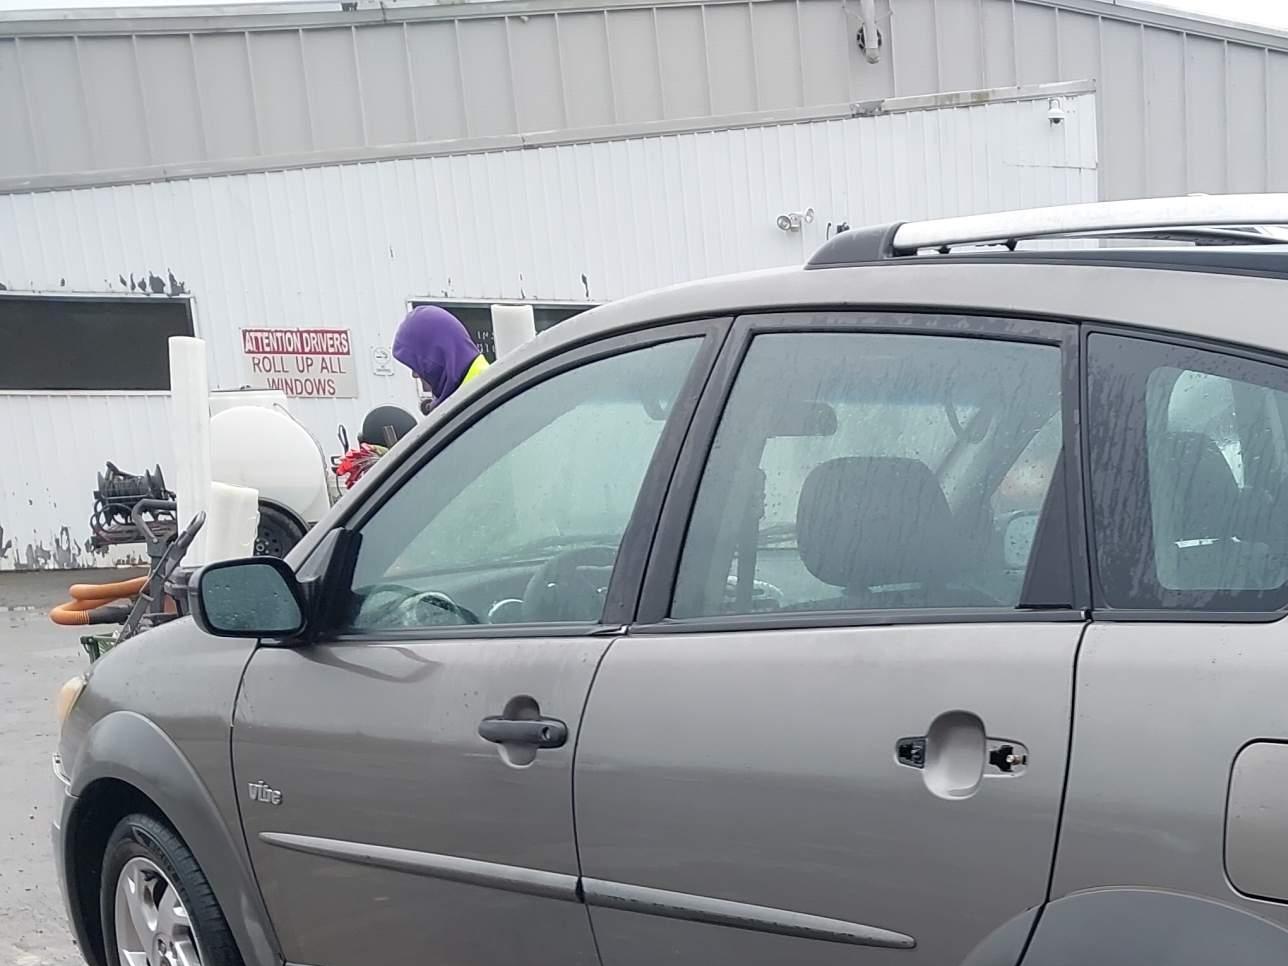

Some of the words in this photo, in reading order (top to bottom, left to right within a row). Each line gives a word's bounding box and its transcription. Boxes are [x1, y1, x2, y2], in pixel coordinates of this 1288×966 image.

[245, 331, 300, 353] ATTENTION
[303, 332, 349, 353] DRIVERS
[252, 356, 289, 373] ROLL
[296, 356, 314, 373] UP
[320, 357, 347, 374] ALL
[267, 377, 336, 396] WINDOWS
